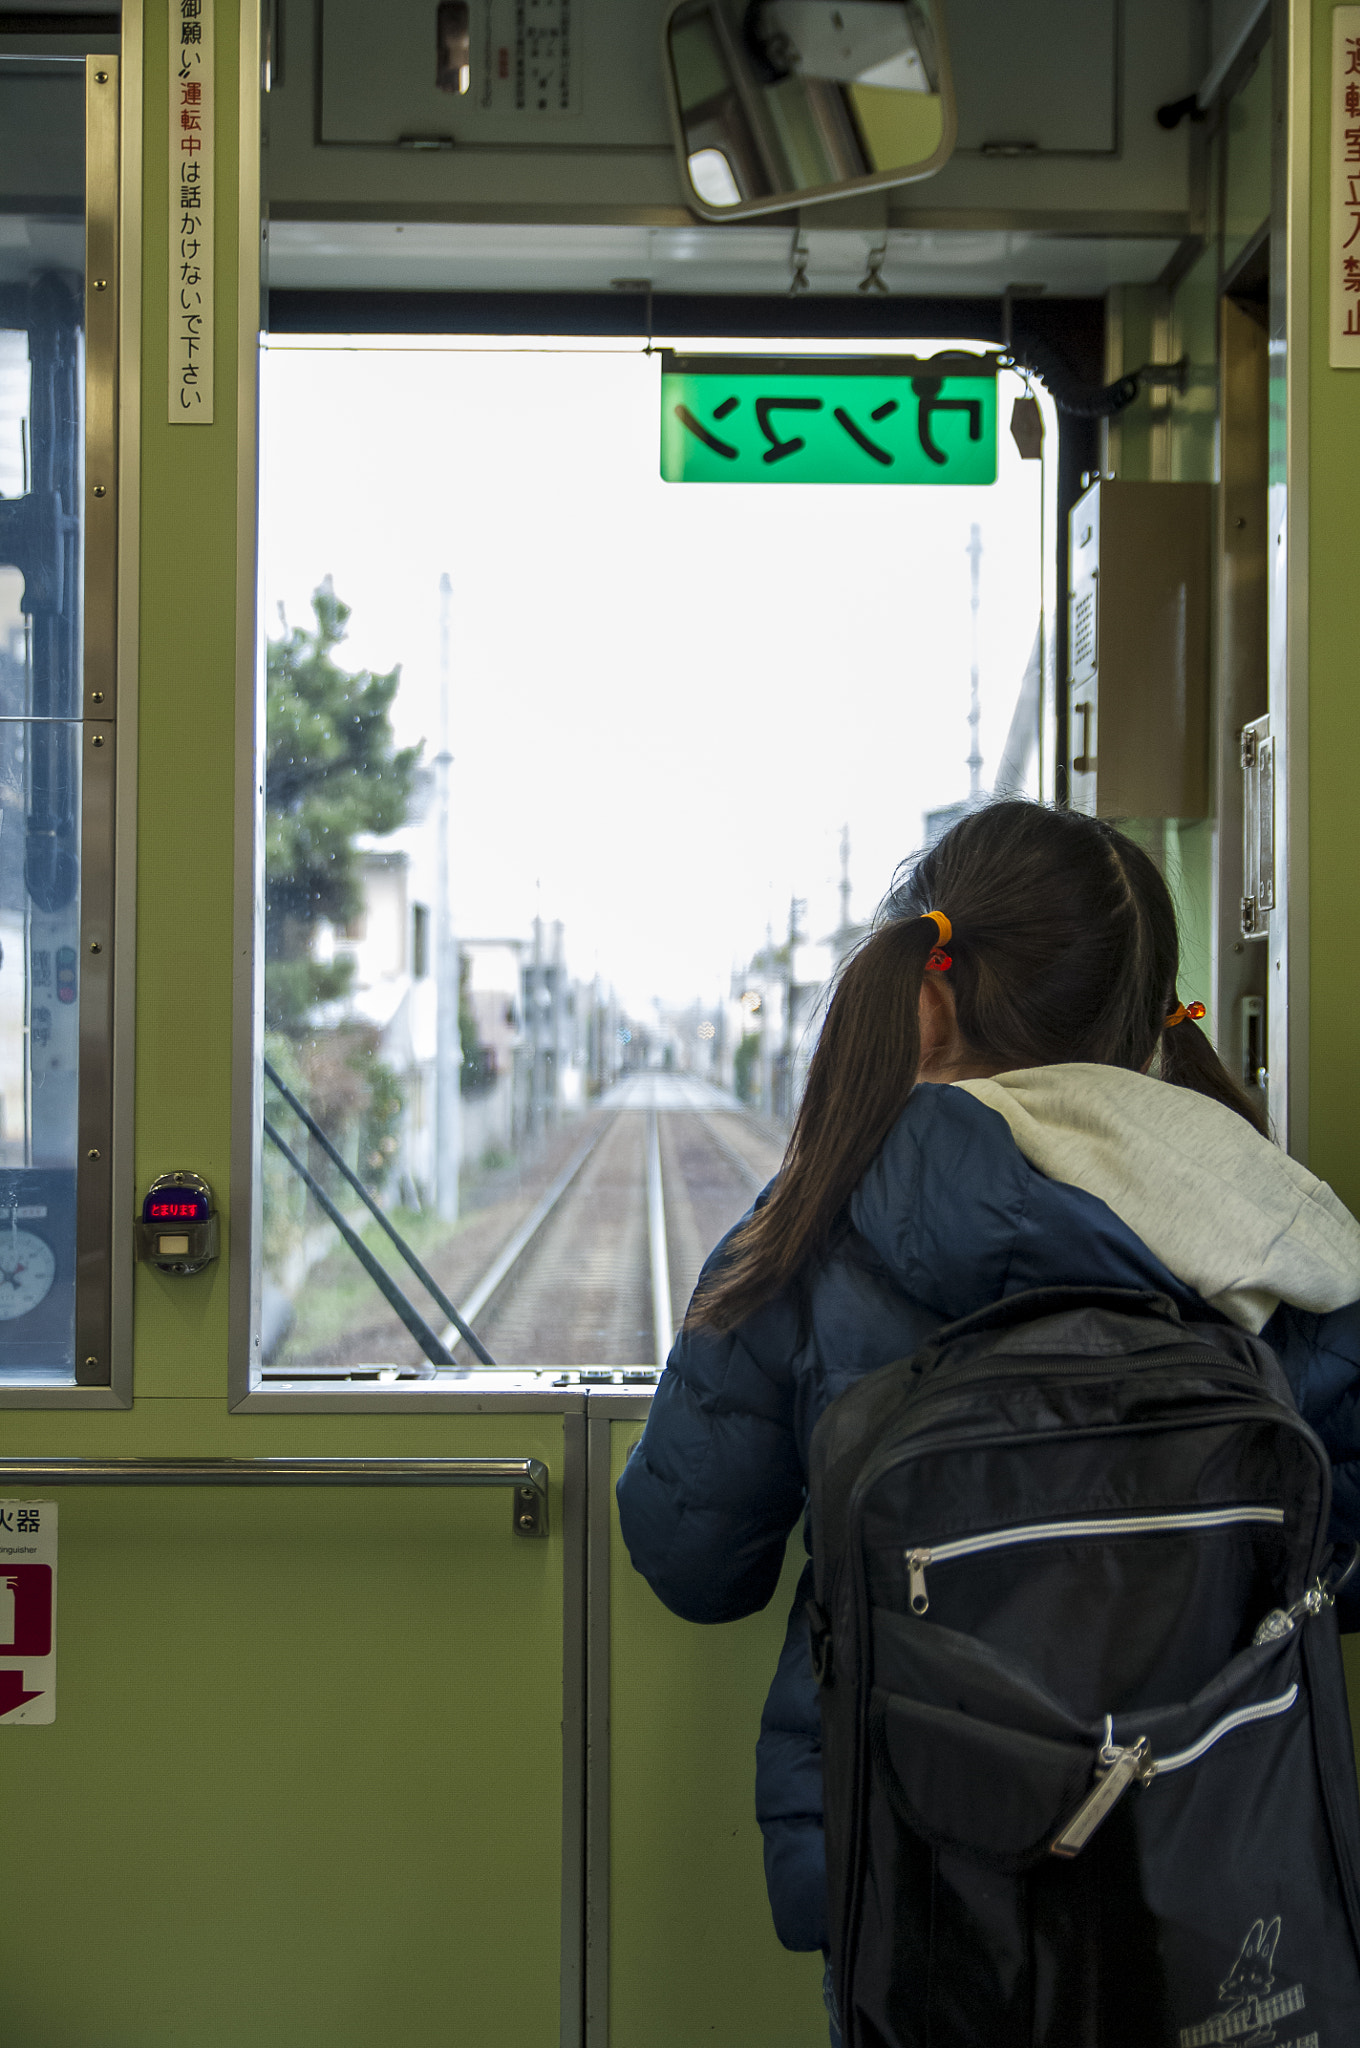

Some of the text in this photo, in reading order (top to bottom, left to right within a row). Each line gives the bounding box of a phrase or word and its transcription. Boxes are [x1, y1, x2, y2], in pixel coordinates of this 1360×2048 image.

[152, 1204, 197, 1216] とまります
